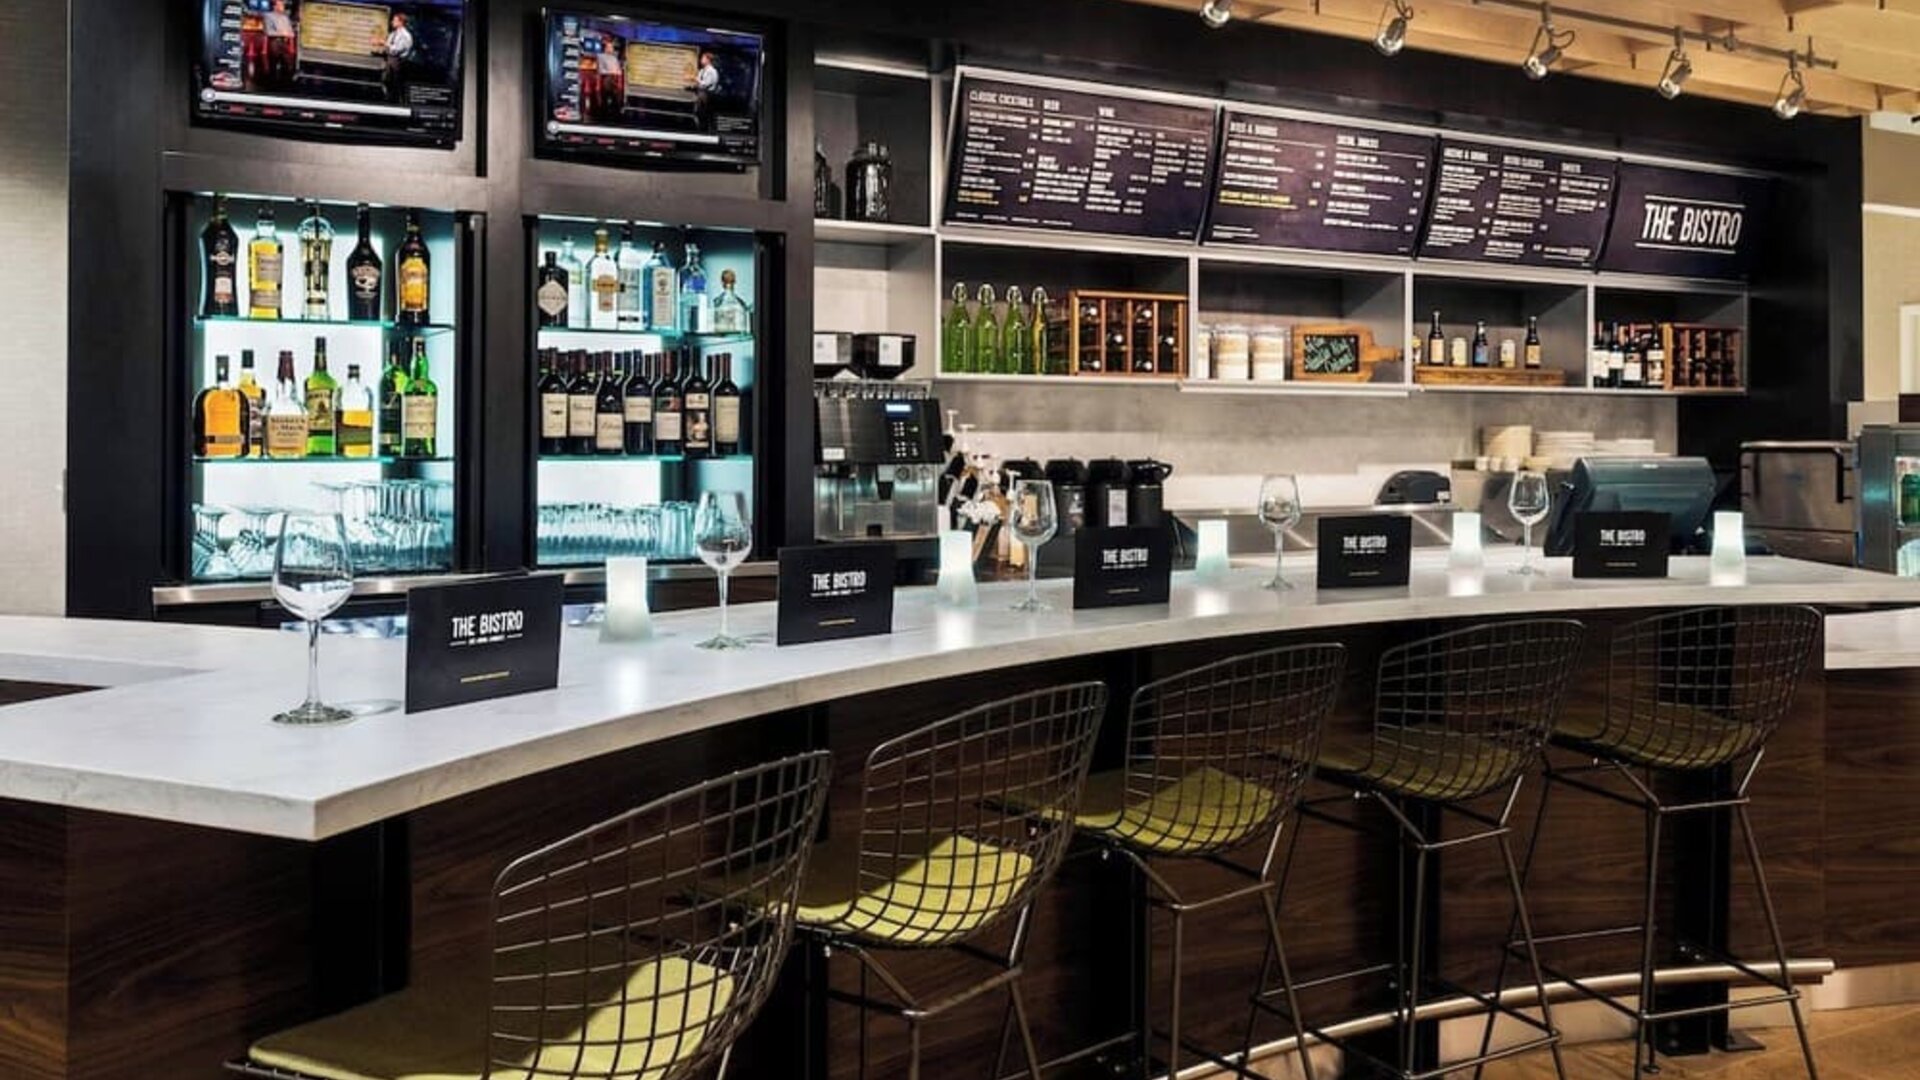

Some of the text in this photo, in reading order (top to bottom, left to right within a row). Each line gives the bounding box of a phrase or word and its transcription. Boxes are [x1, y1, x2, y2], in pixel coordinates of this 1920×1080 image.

[1643, 203, 1742, 246] THE BISTRO
[1343, 535, 1387, 549] THE BISTRO
[1600, 529, 1646, 542] THE BISTRO
[1103, 548, 1149, 564] THE BISTRO
[812, 571, 867, 590] THE BISTRO
[452, 610, 524, 638] THE BISTRO
